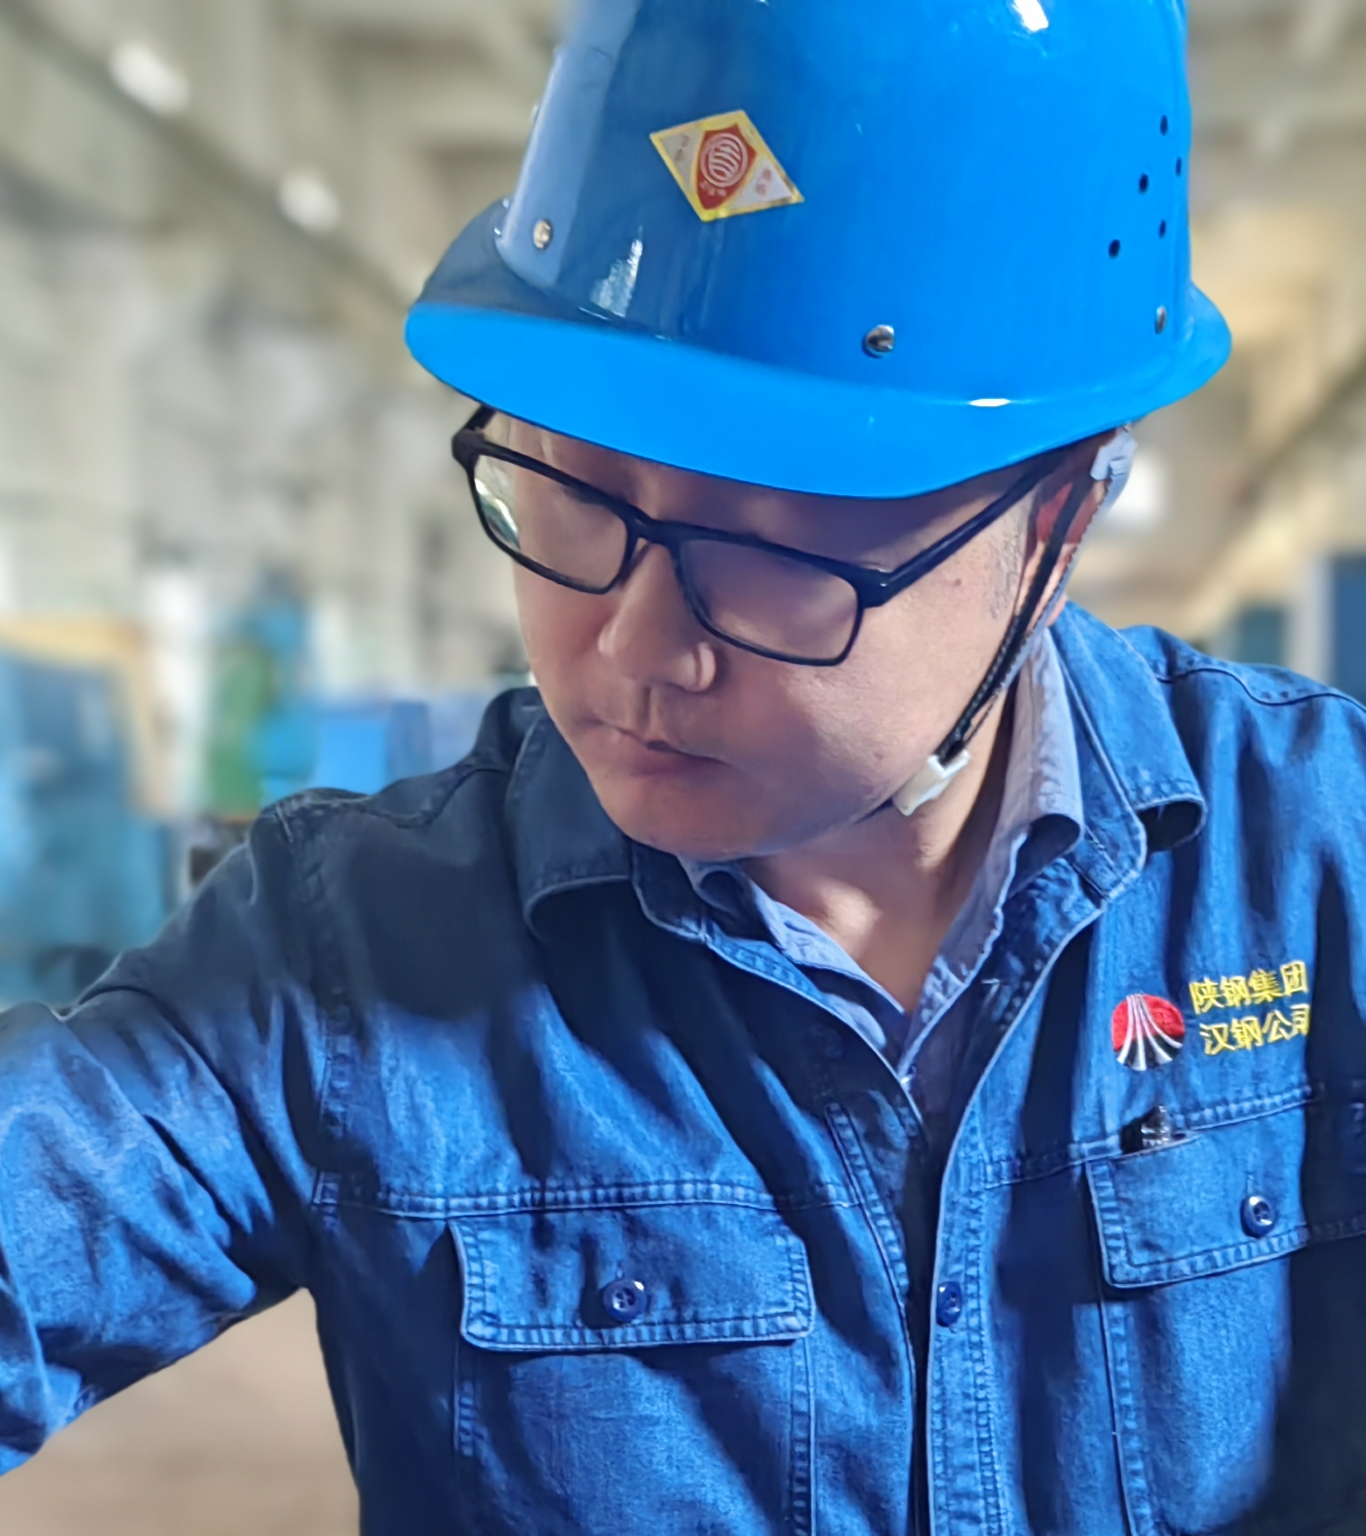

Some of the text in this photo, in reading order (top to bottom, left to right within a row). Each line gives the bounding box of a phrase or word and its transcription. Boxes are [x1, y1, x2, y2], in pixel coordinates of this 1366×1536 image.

[1189, 961, 1308, 1014] 陕钢集团
[1199, 1003, 1310, 1055] 汉钢公司
